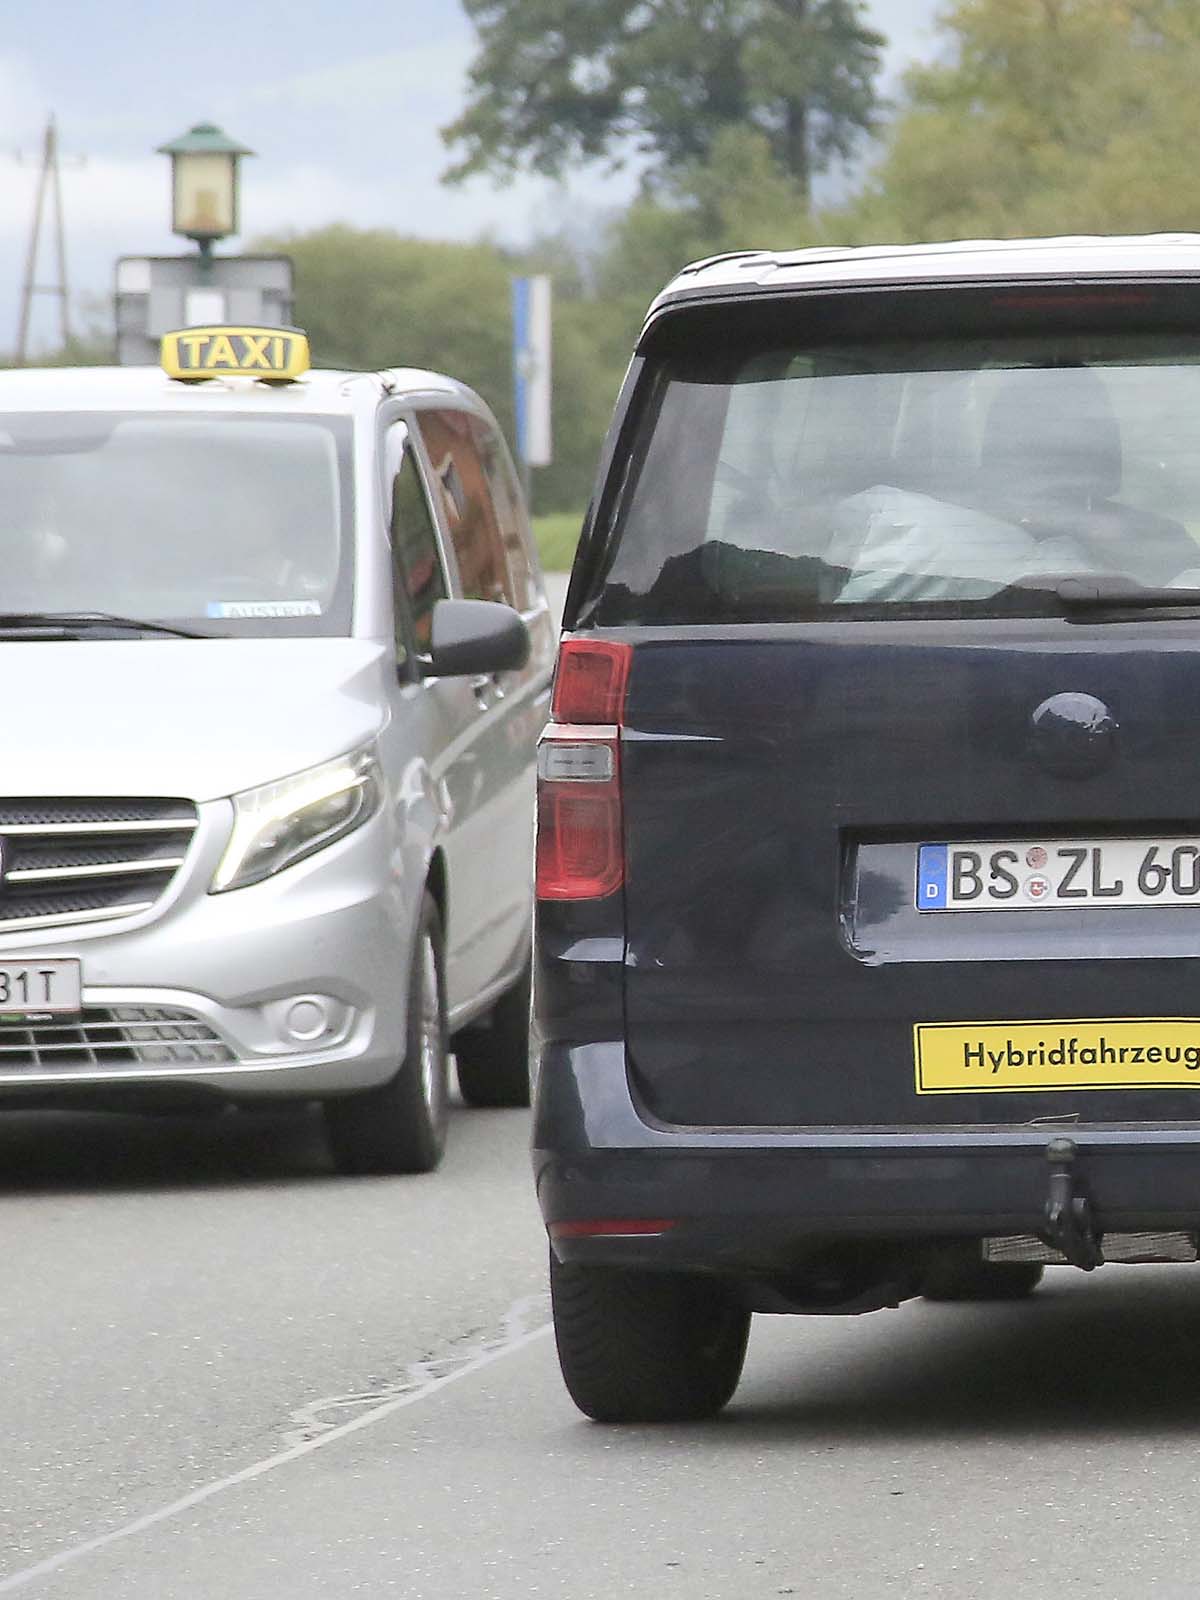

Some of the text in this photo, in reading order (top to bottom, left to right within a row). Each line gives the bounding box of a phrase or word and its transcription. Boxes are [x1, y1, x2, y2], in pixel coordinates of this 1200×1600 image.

[182, 335, 285, 369] TAXI
[230, 605, 320, 618] AUSTRIA
[952, 850, 1019, 900] BS
[1057, 847, 1123, 898] ZL
[926, 883, 938, 898] D
